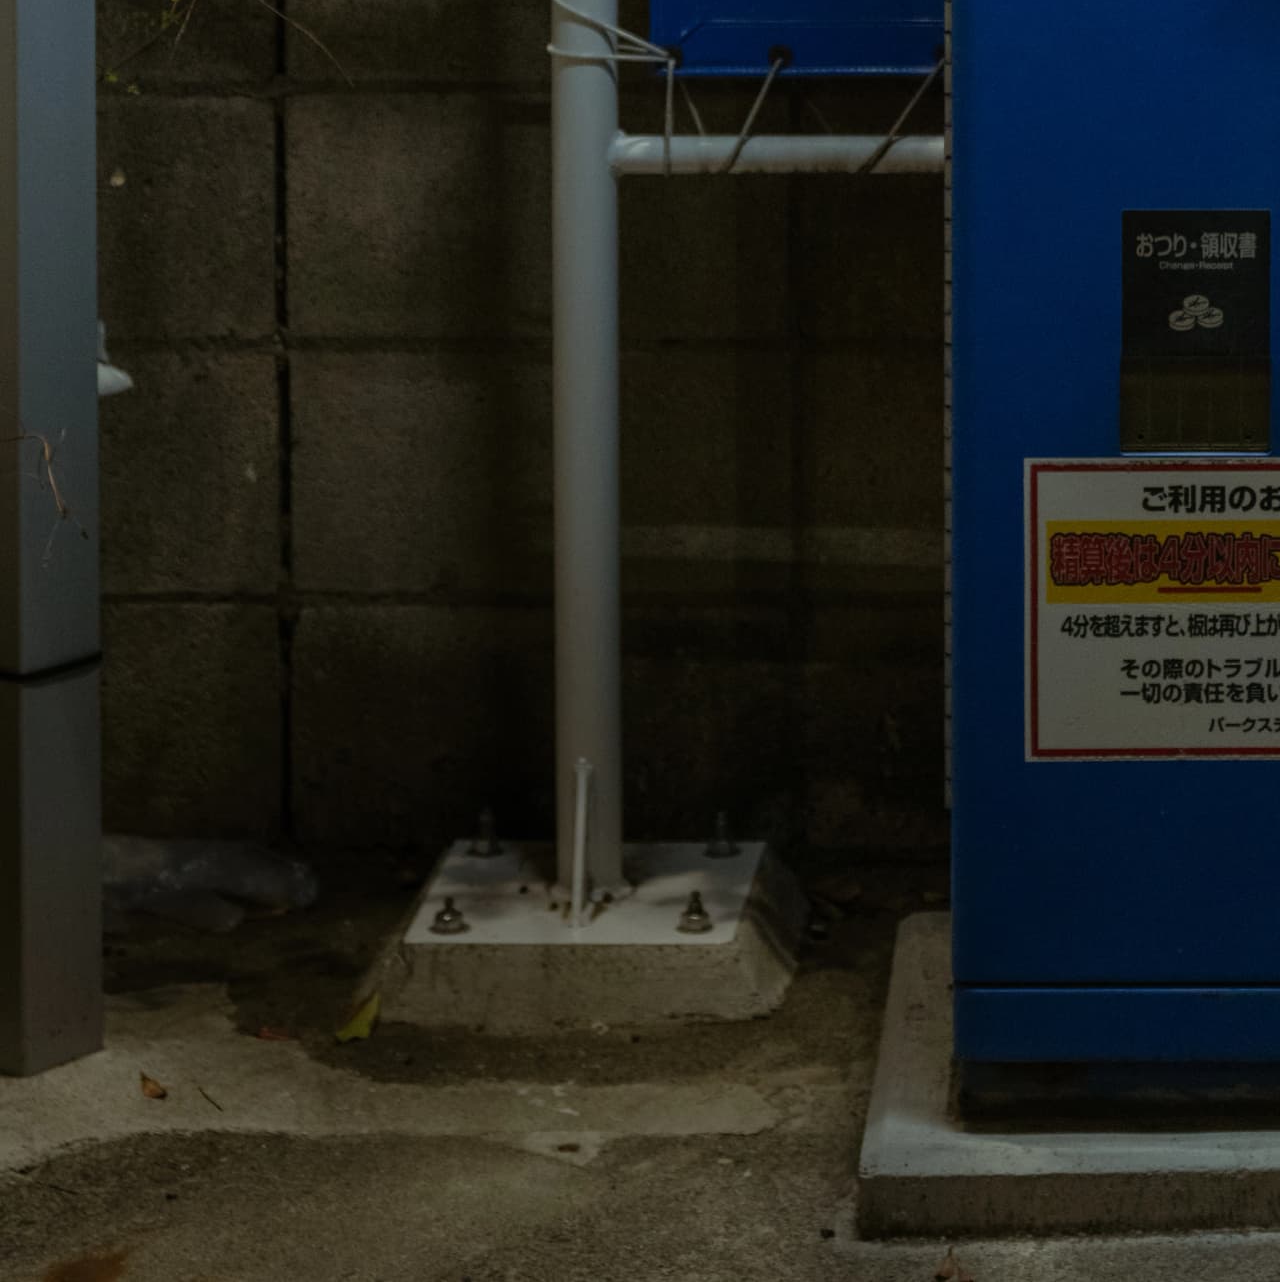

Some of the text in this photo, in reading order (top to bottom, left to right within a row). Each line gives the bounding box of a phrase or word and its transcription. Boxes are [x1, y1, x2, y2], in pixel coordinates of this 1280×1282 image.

[1136, 232, 1257, 259] おつり・領収書
